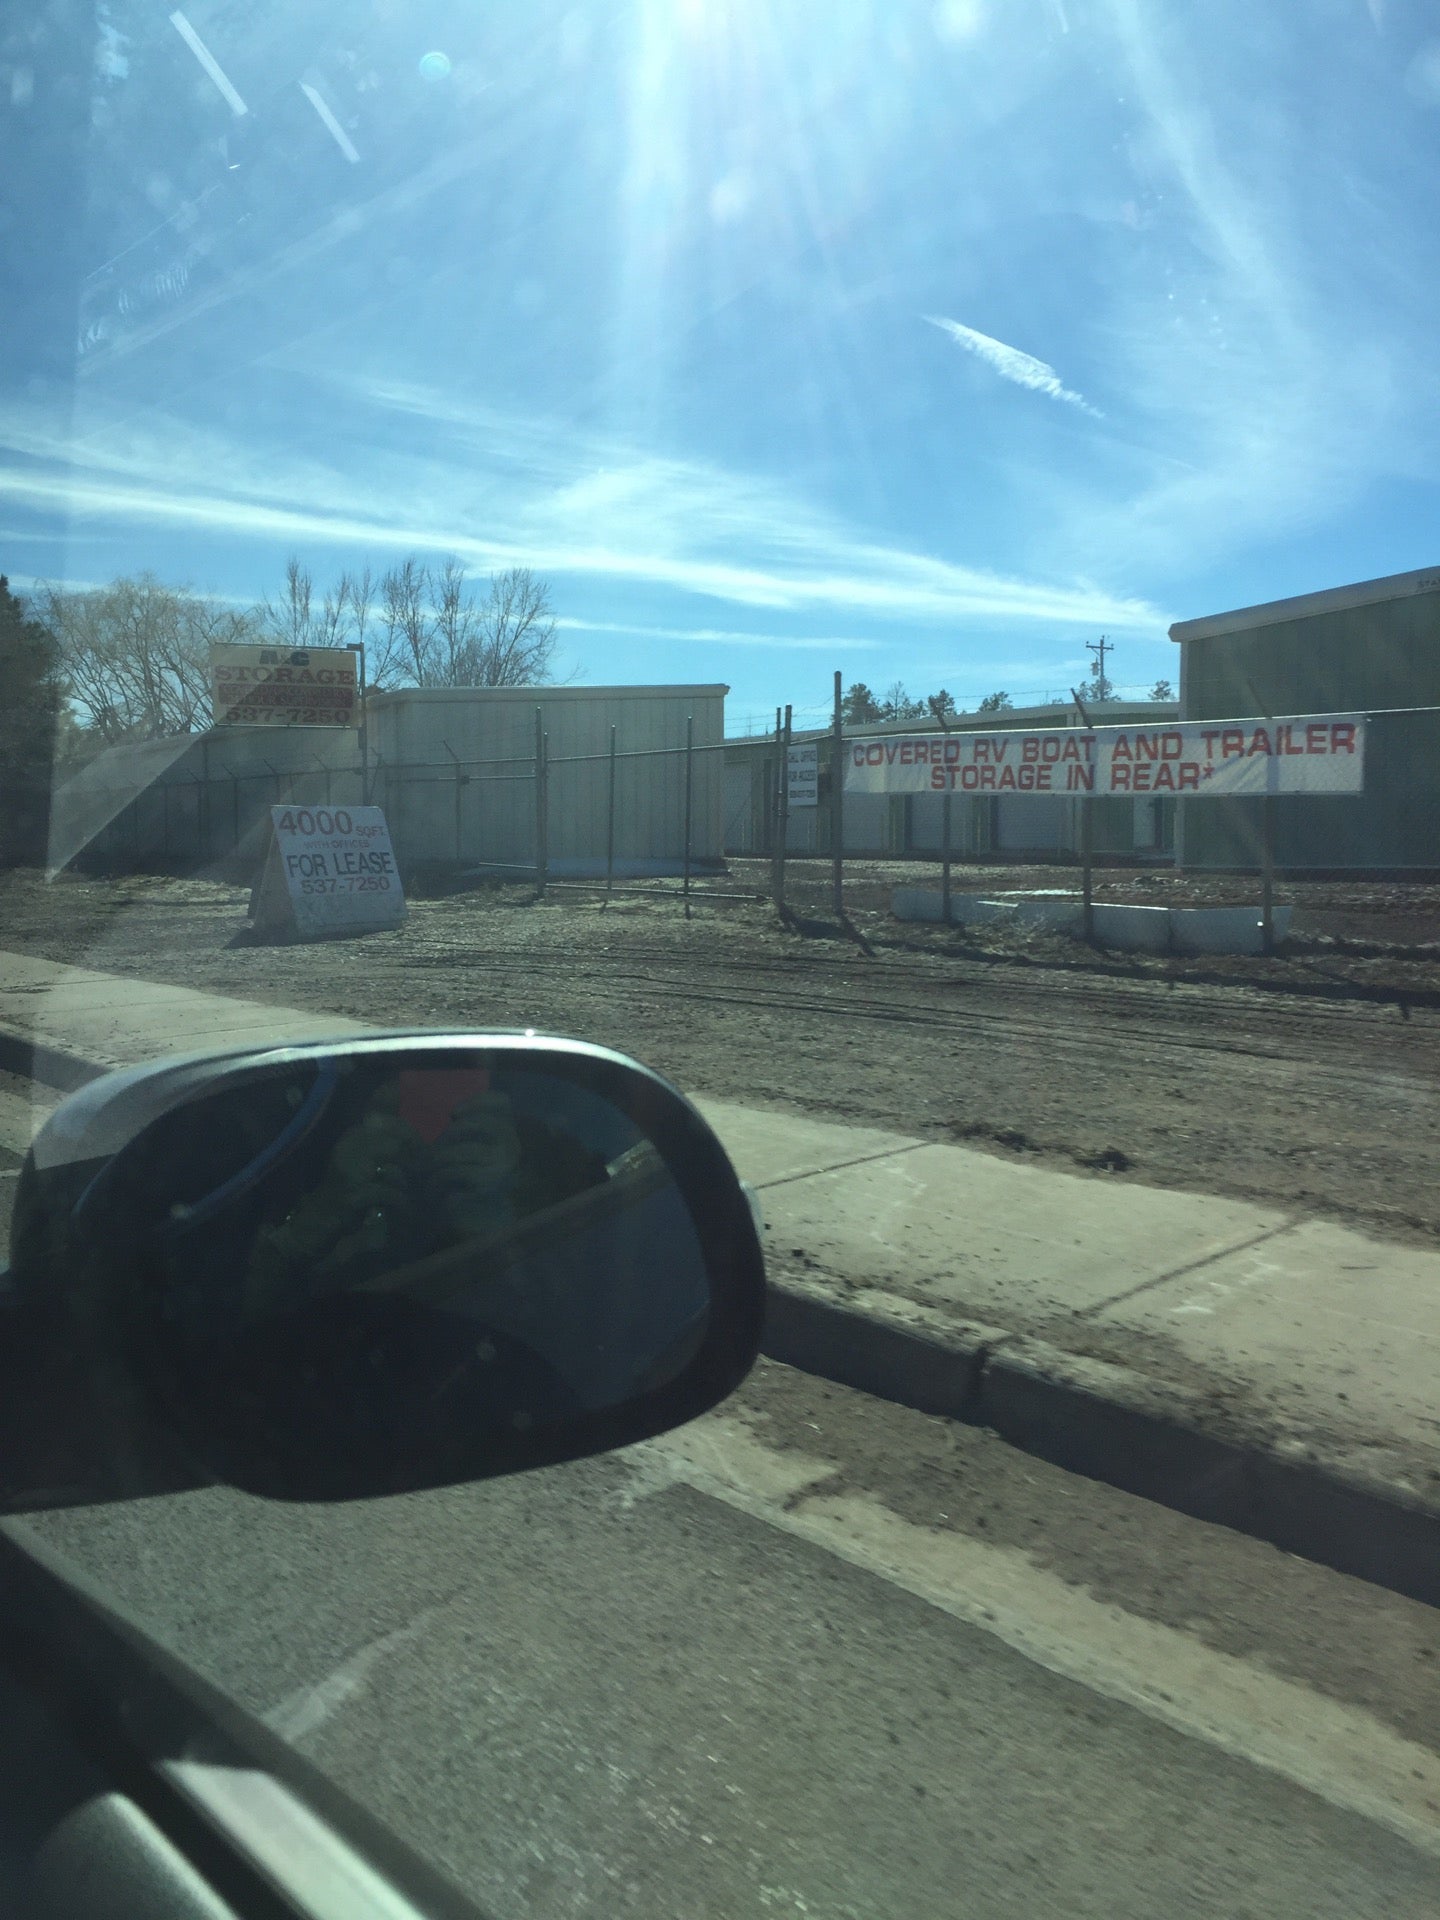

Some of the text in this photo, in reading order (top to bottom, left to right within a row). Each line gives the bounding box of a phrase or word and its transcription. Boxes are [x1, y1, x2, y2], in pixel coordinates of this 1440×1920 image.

[215, 665, 355, 685] STORAGE
[853, 722, 1356, 767] COVERED RV BOAT AND TRAILER
[930, 764, 1053, 790] STORAGE
[1066, 764, 1095, 791] IN
[279, 810, 352, 836] 4000
[286, 851, 395, 877] FOR LEASE
[301, 876, 390, 894] 537-7250
